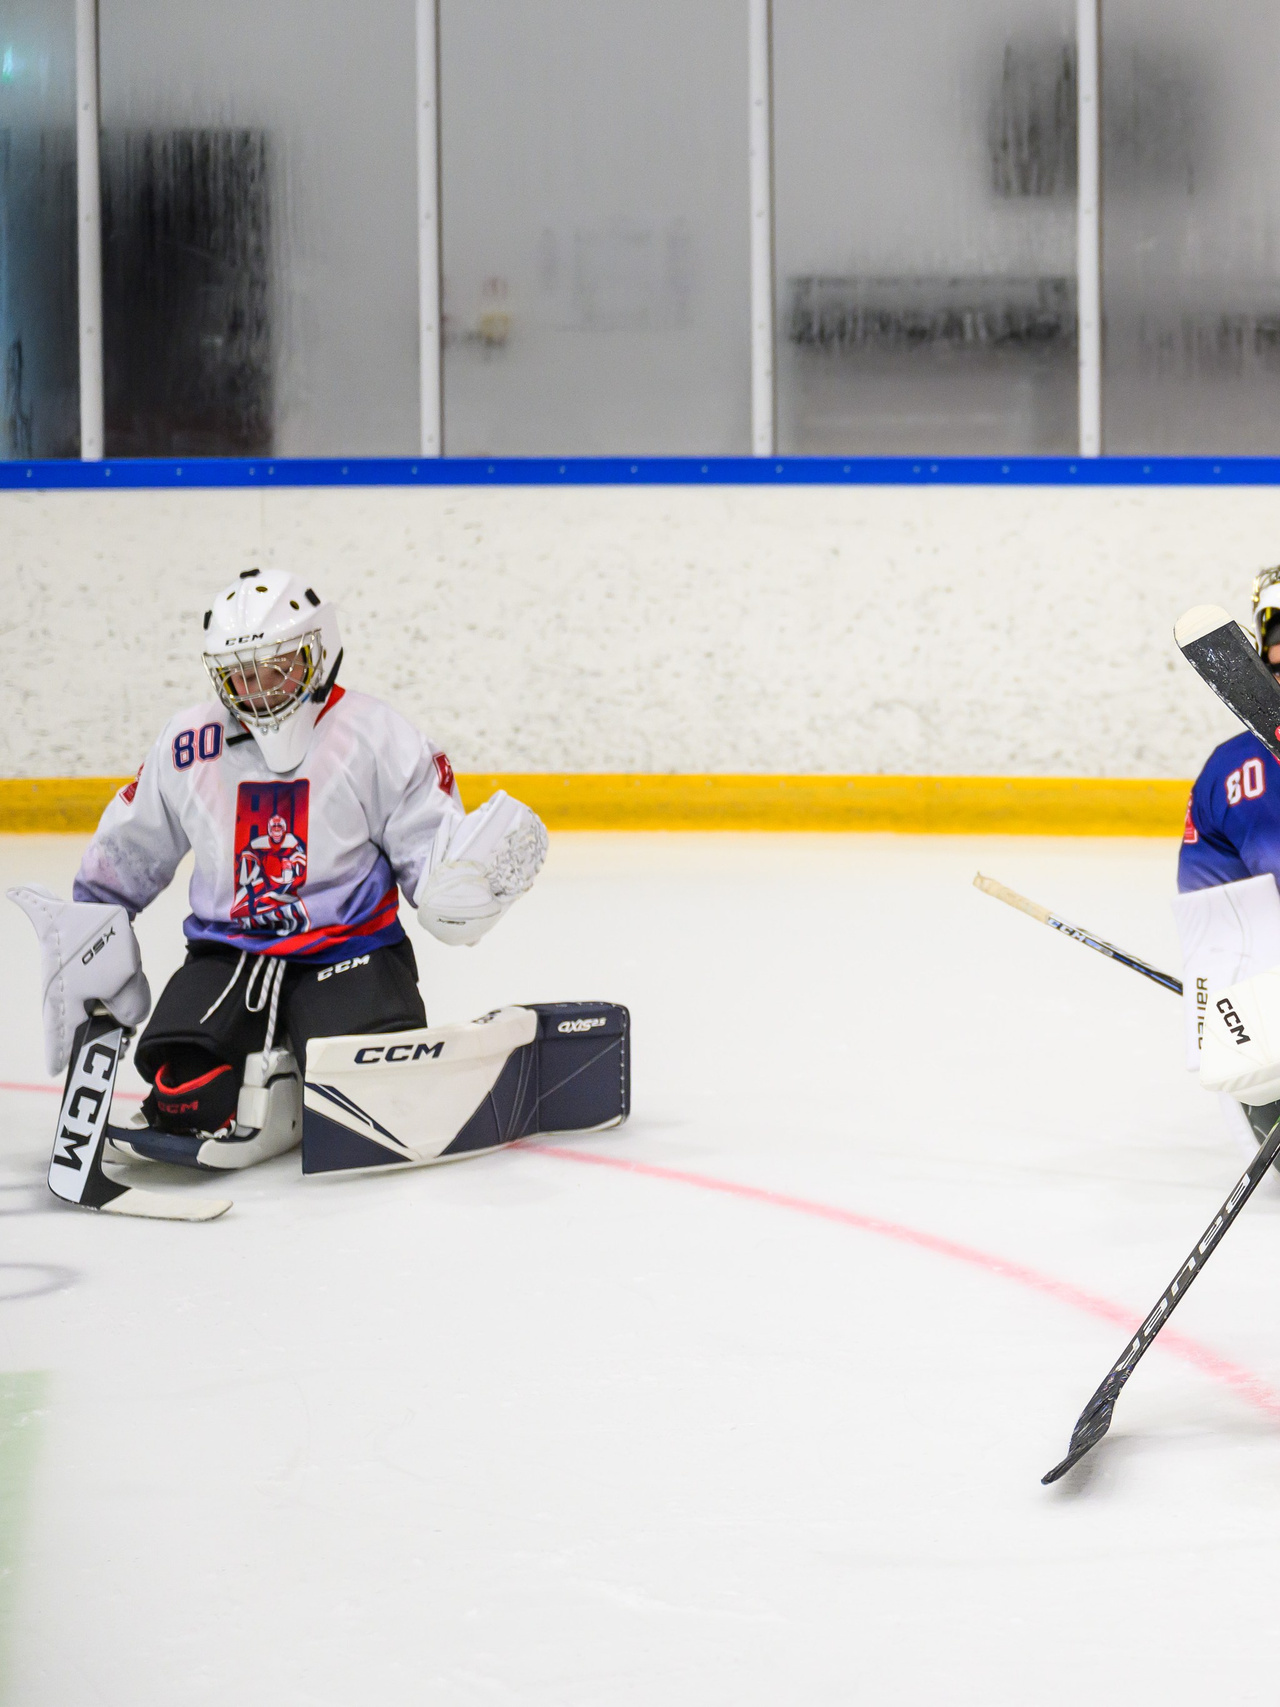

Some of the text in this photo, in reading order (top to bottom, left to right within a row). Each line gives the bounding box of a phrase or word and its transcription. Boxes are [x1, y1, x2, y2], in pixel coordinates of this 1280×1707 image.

[225, 633, 264, 646] CCM
[171, 720, 225, 772] 80
[1224, 757, 1266, 807] 80
[317, 955, 370, 982] CCM
[1216, 998, 1251, 1045] CCM
[354, 1041, 445, 1065] CCM
[53, 1043, 117, 1172] CCM
